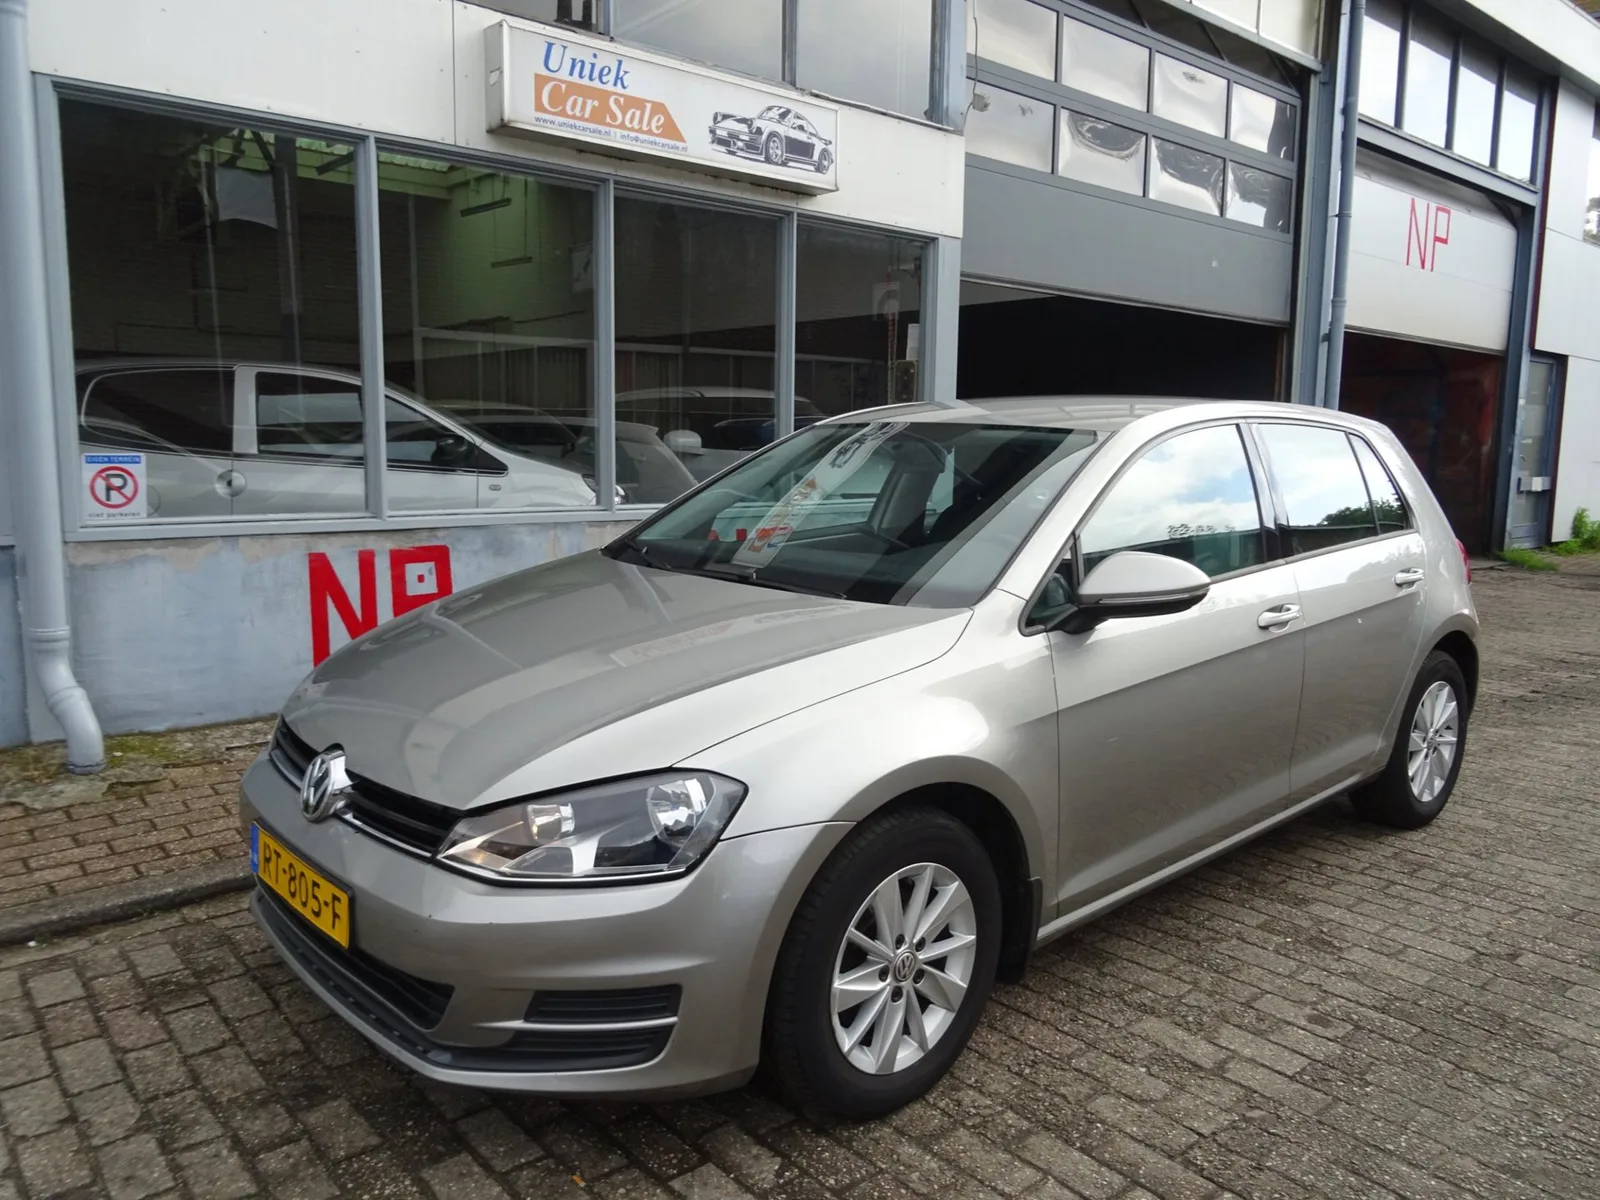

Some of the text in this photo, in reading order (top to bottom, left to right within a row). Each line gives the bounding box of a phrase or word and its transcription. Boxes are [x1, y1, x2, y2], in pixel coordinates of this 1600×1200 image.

[543, 41, 630, 90] Uniek
[534, 116, 688, 152] www.uniekcarsale.nl info@uniekcarsale.nl
[541, 81, 665, 134] Car Sale
[1406, 197, 1451, 272] NP
[105, 474, 127, 502] P
[308, 544, 453, 668] NP
[263, 841, 341, 930] RT-805-F
